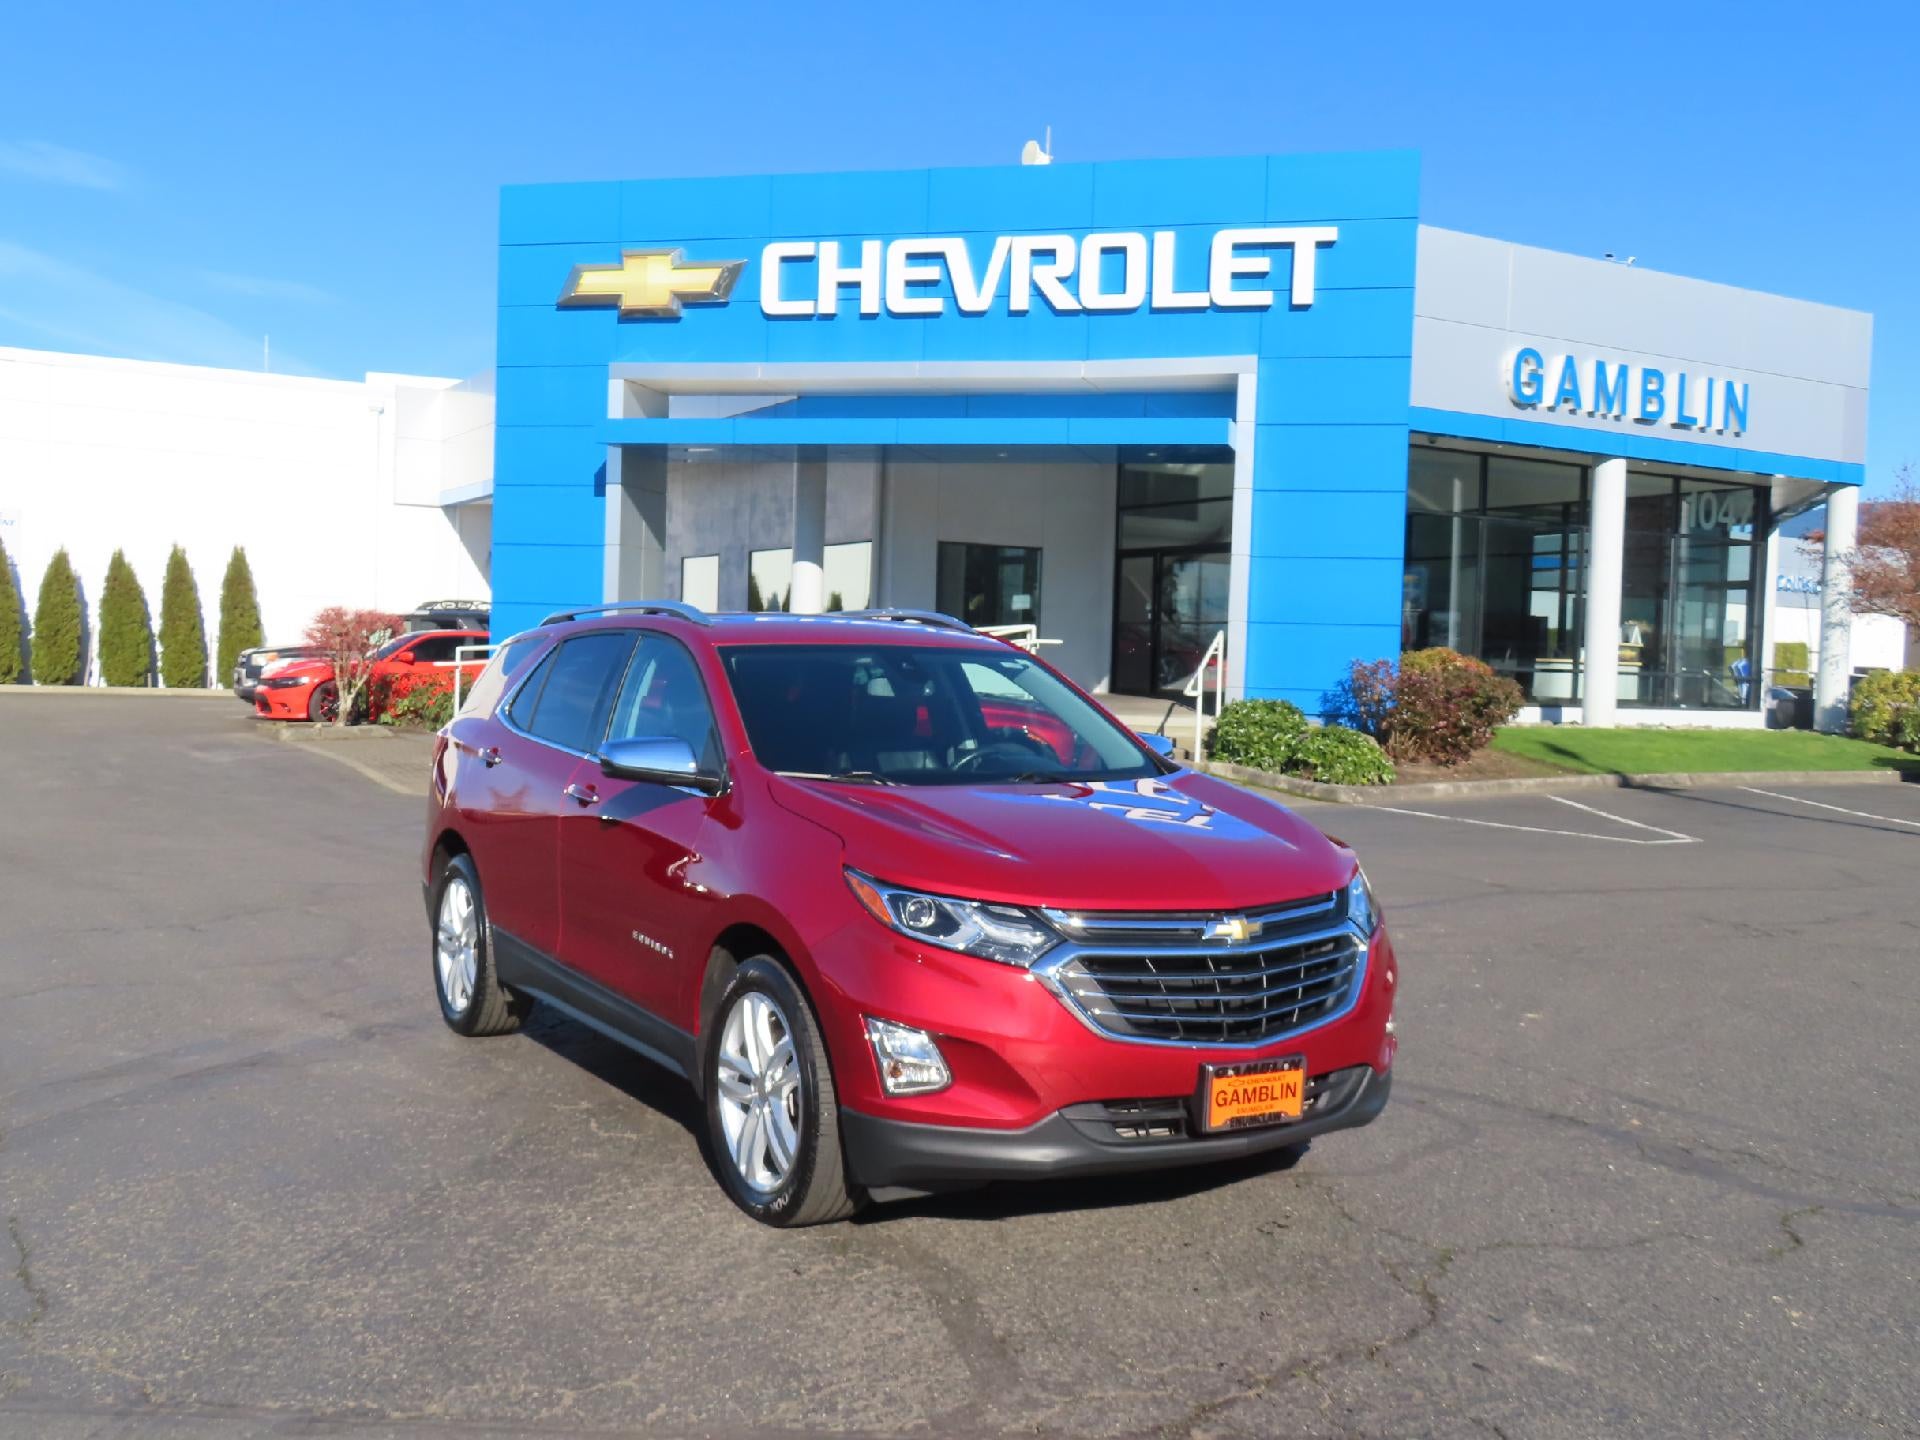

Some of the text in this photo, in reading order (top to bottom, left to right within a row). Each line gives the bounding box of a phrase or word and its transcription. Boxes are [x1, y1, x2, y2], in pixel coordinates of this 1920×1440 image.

[760, 226, 1339, 317] CHEVROLET
[1511, 346, 1750, 434] GAMBLIN
[1215, 1082, 1297, 1107] GAMBLIN
